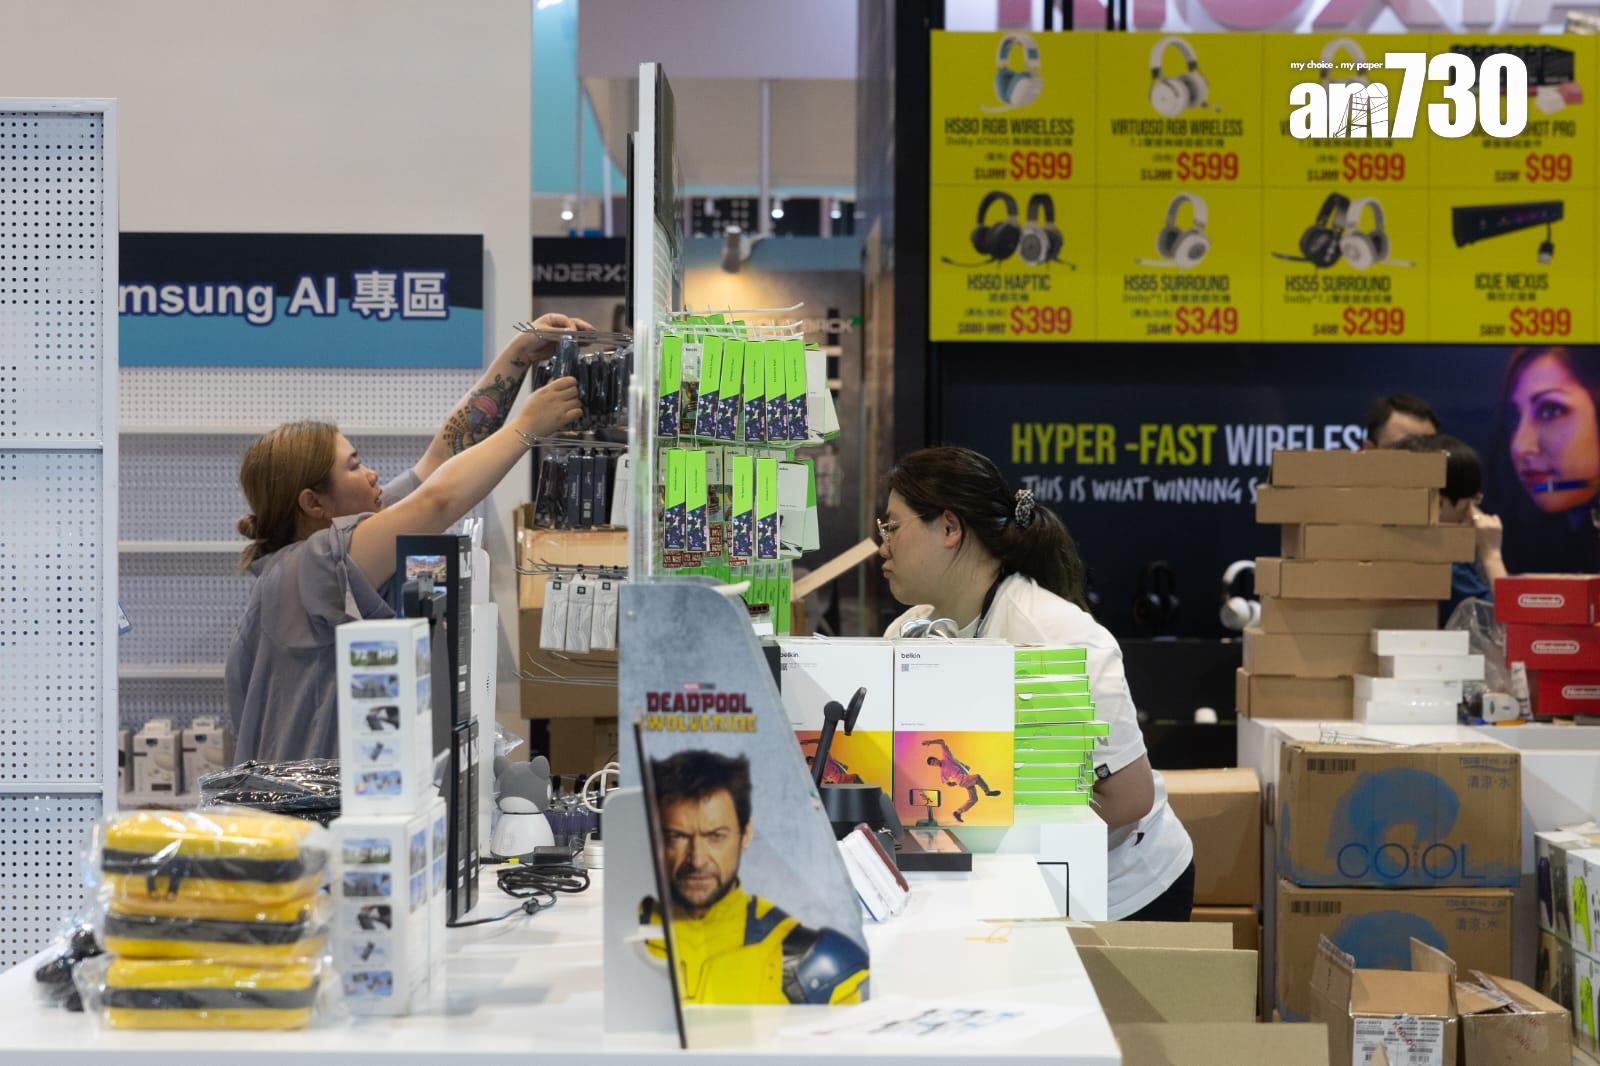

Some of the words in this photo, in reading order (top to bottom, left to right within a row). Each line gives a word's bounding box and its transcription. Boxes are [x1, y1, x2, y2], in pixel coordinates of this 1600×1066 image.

[945, 118, 979, 134] HS80
[982, 118, 1008, 134] RGB
[1010, 118, 1074, 135] WIRELESS
[1111, 119, 1163, 136] VIRTUOSO
[1190, 119, 1243, 136] WIRELESS
[1552, 120, 1576, 137] PRO
[1010, 150, 1072, 181] $699
[1177, 152, 1239, 181] $599
[1343, 152, 1405, 182] $699
[1525, 152, 1572, 183] $99
[288, 276, 336, 314] AI
[351, 270, 448, 318] 專區
[1004, 274, 1050, 291] HAPTIC
[1161, 274, 1229, 291] SURROUND
[1322, 275, 1391, 292] SURROUND
[1505, 273, 1549, 290] NEXUS
[1010, 306, 1072, 336] $399
[1175, 306, 1238, 336] $349
[1343, 306, 1405, 336] $299
[1509, 307, 1571, 337] $399
[1011, 423, 1116, 465] HYPER
[1225, 424, 1368, 467] WIRELES
[1022, 475, 1063, 502] THIS
[1069, 475, 1086, 503] IS
[1094, 476, 1150, 503] WHAT
[1152, 476, 1242, 504] WINNING
[646, 692, 752, 713] DEADPOOL
[646, 714, 757, 734] WOLVERINE
